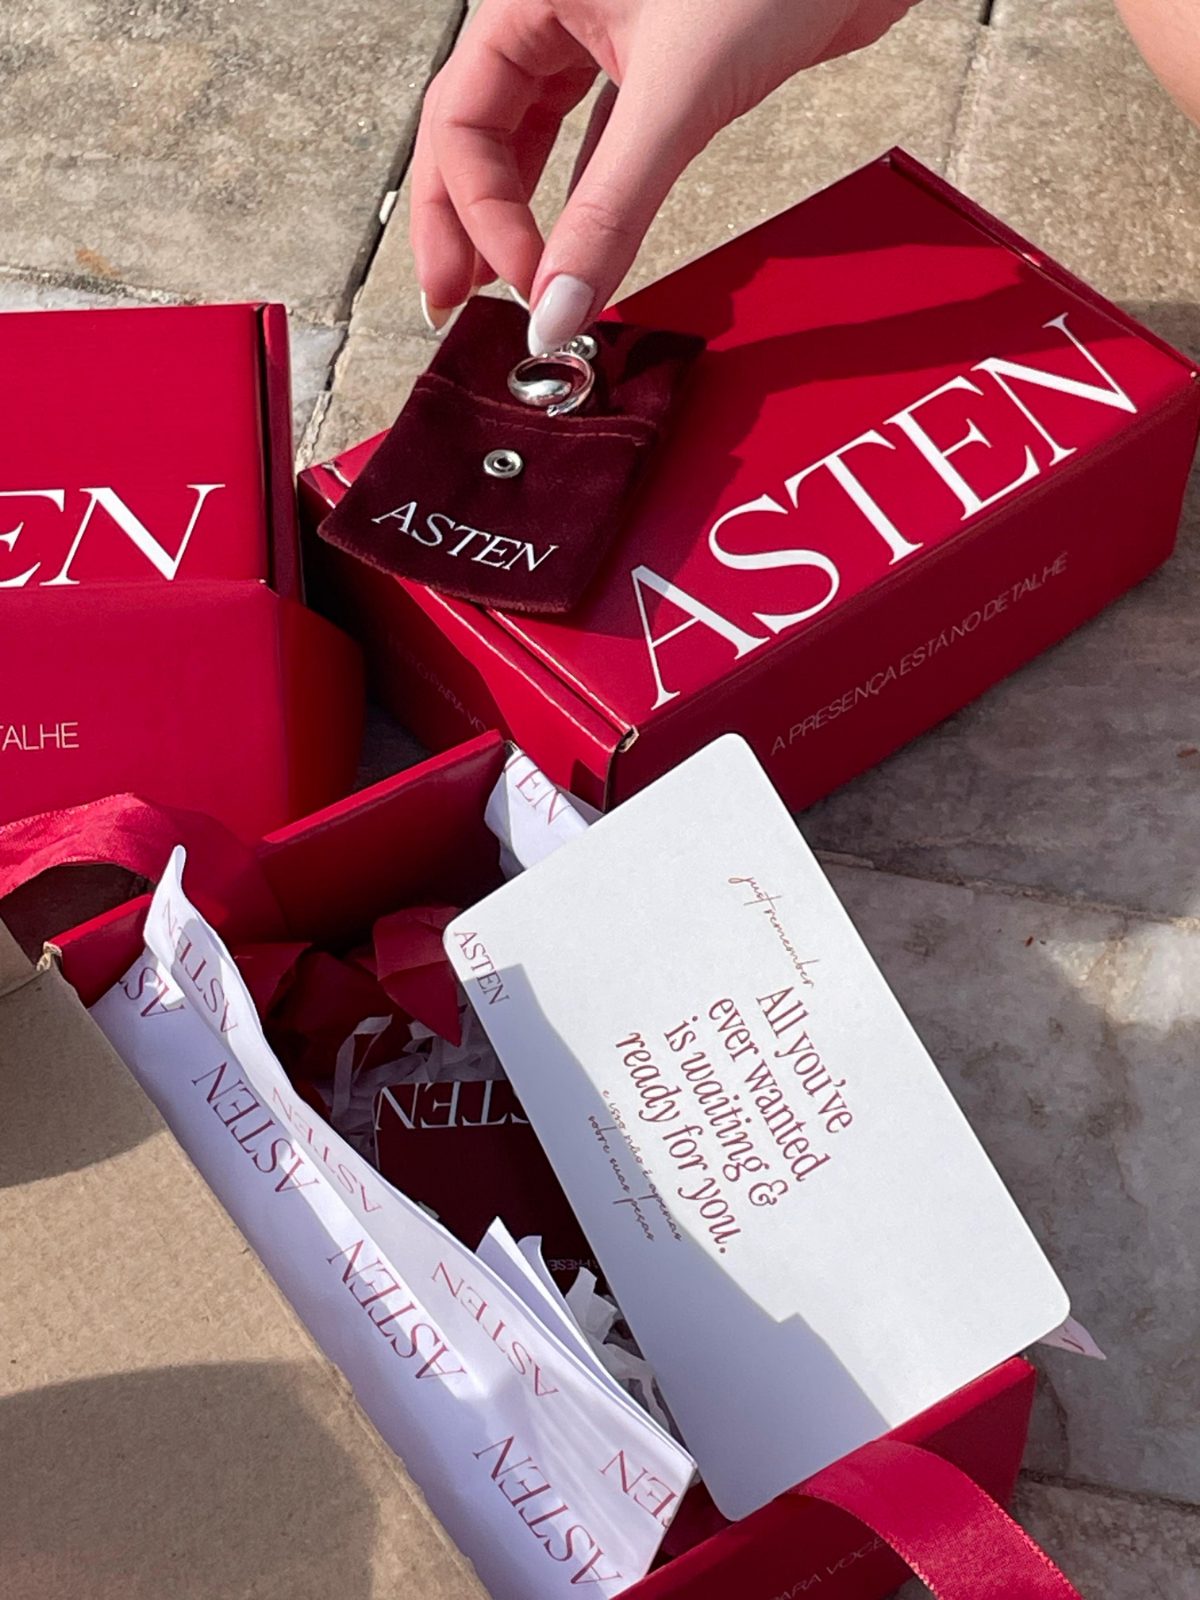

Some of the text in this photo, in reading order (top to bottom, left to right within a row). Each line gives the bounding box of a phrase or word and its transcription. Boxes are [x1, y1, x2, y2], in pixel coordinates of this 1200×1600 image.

[371, 501, 559, 571] ASTEN
[631, 312, 1137, 710] ASTEN
[119, 966, 184, 1018] AS
[453, 929, 510, 1006] ASTEN
[728, 876, 820, 988] just remember
[664, 1015, 788, 1207] is waiting &
[708, 998, 831, 1183] ever wanted
[756, 986, 853, 1134] All you've
[191, 1062, 320, 1193] ASTEN
[270, 1086, 383, 1213] ASTEN
[588, 1115, 618, 1151] sobre
[608, 1156, 630, 1193] suas
[615, 1032, 741, 1254] ready for you.
[639, 1181, 681, 1242] apenas
[327, 1239, 467, 1380] ASTEN
[431, 1261, 560, 1397] ASTEN
[473, 1436, 624, 1585] ASTEN
